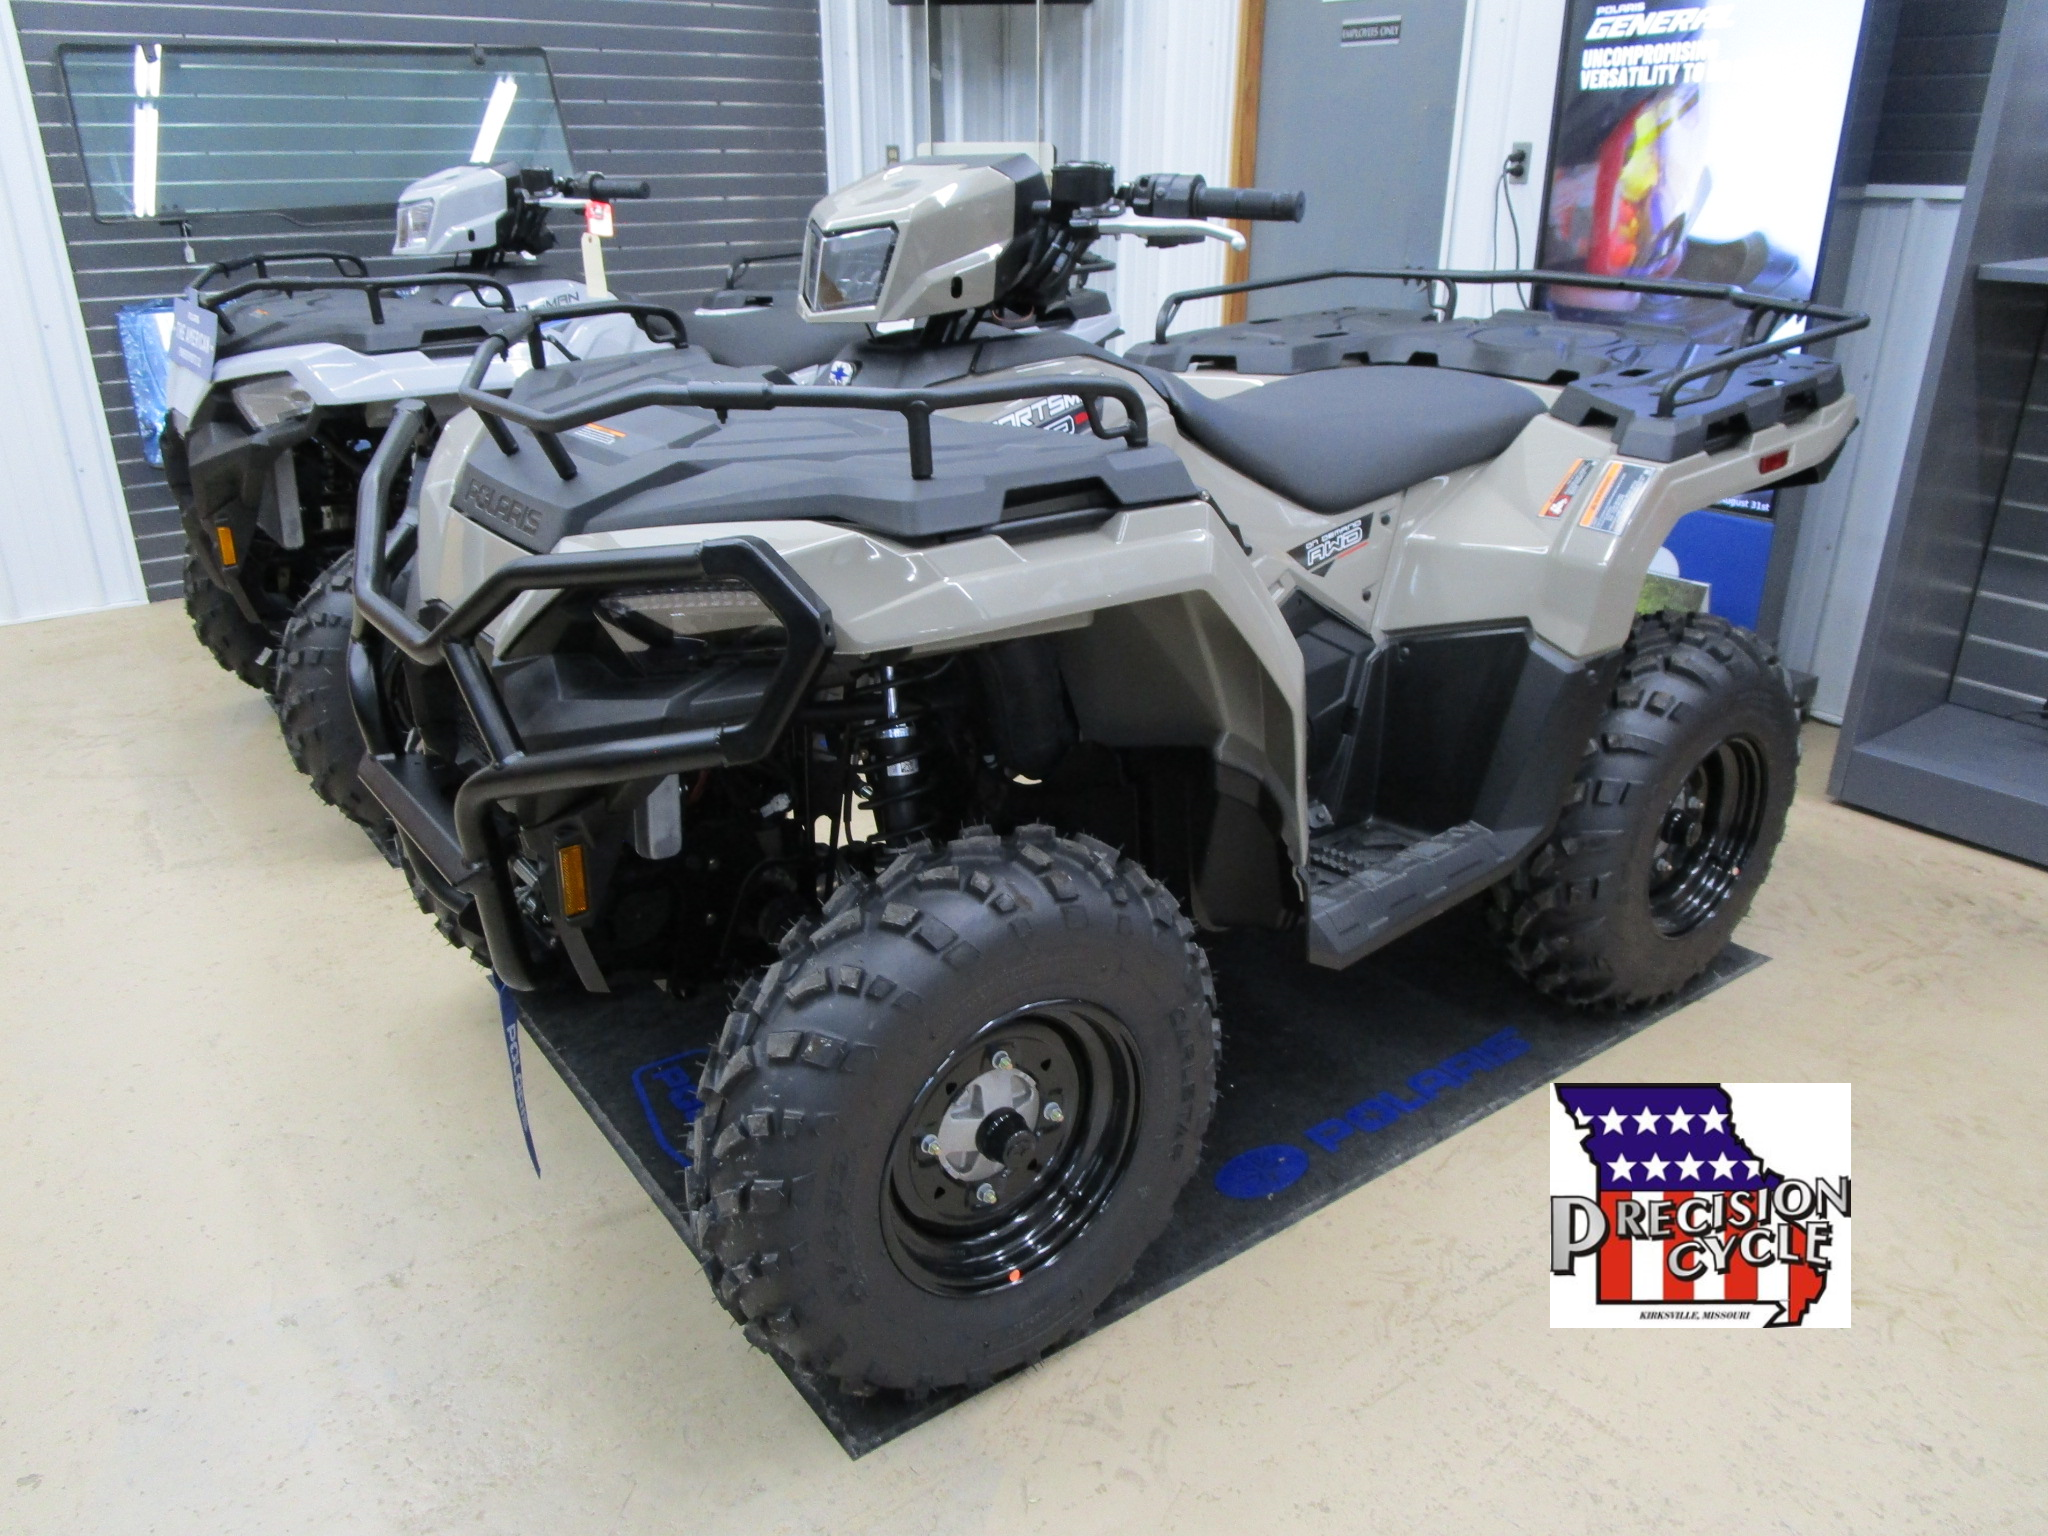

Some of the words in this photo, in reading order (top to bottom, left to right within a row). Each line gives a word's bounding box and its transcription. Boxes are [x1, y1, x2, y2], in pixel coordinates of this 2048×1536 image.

[1596, 1, 1646, 15] POLARIS
[1580, 63, 1680, 91] VERSATILITY
[1683, 61, 1705, 84] TO
[464, 478, 543, 537] POLARIS
[1306, 527, 1363, 567] AWD
[1321, 519, 1362, 543] DEMAND
[1303, 1026, 1533, 1152] POLARIS
